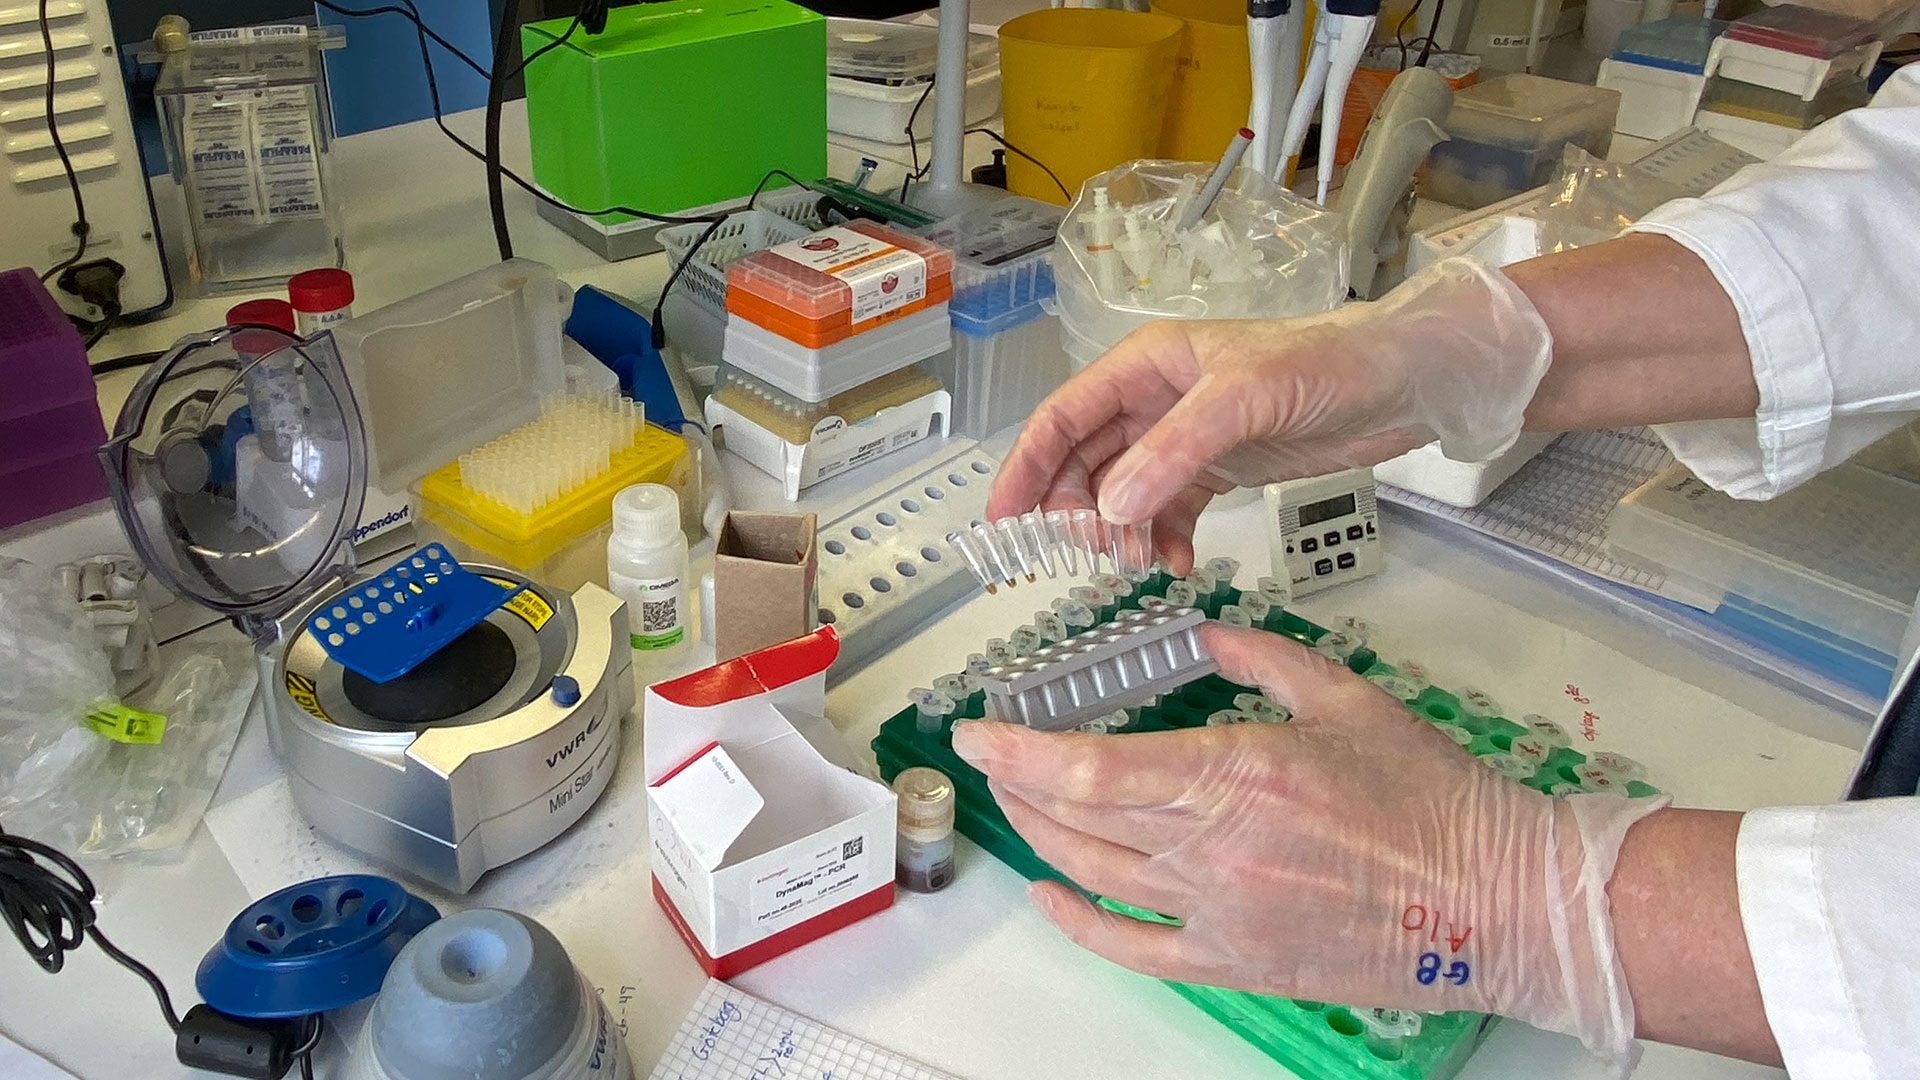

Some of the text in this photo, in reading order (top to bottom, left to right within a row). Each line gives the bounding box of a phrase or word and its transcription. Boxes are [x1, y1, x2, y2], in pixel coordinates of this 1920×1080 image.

[352, 504, 409, 542] ppendorf
[546, 731, 586, 769] VWR
[827, 862, 847, 877] PCR
[1402, 904, 1473, 953] A10
[1416, 952, 1470, 986] G8
